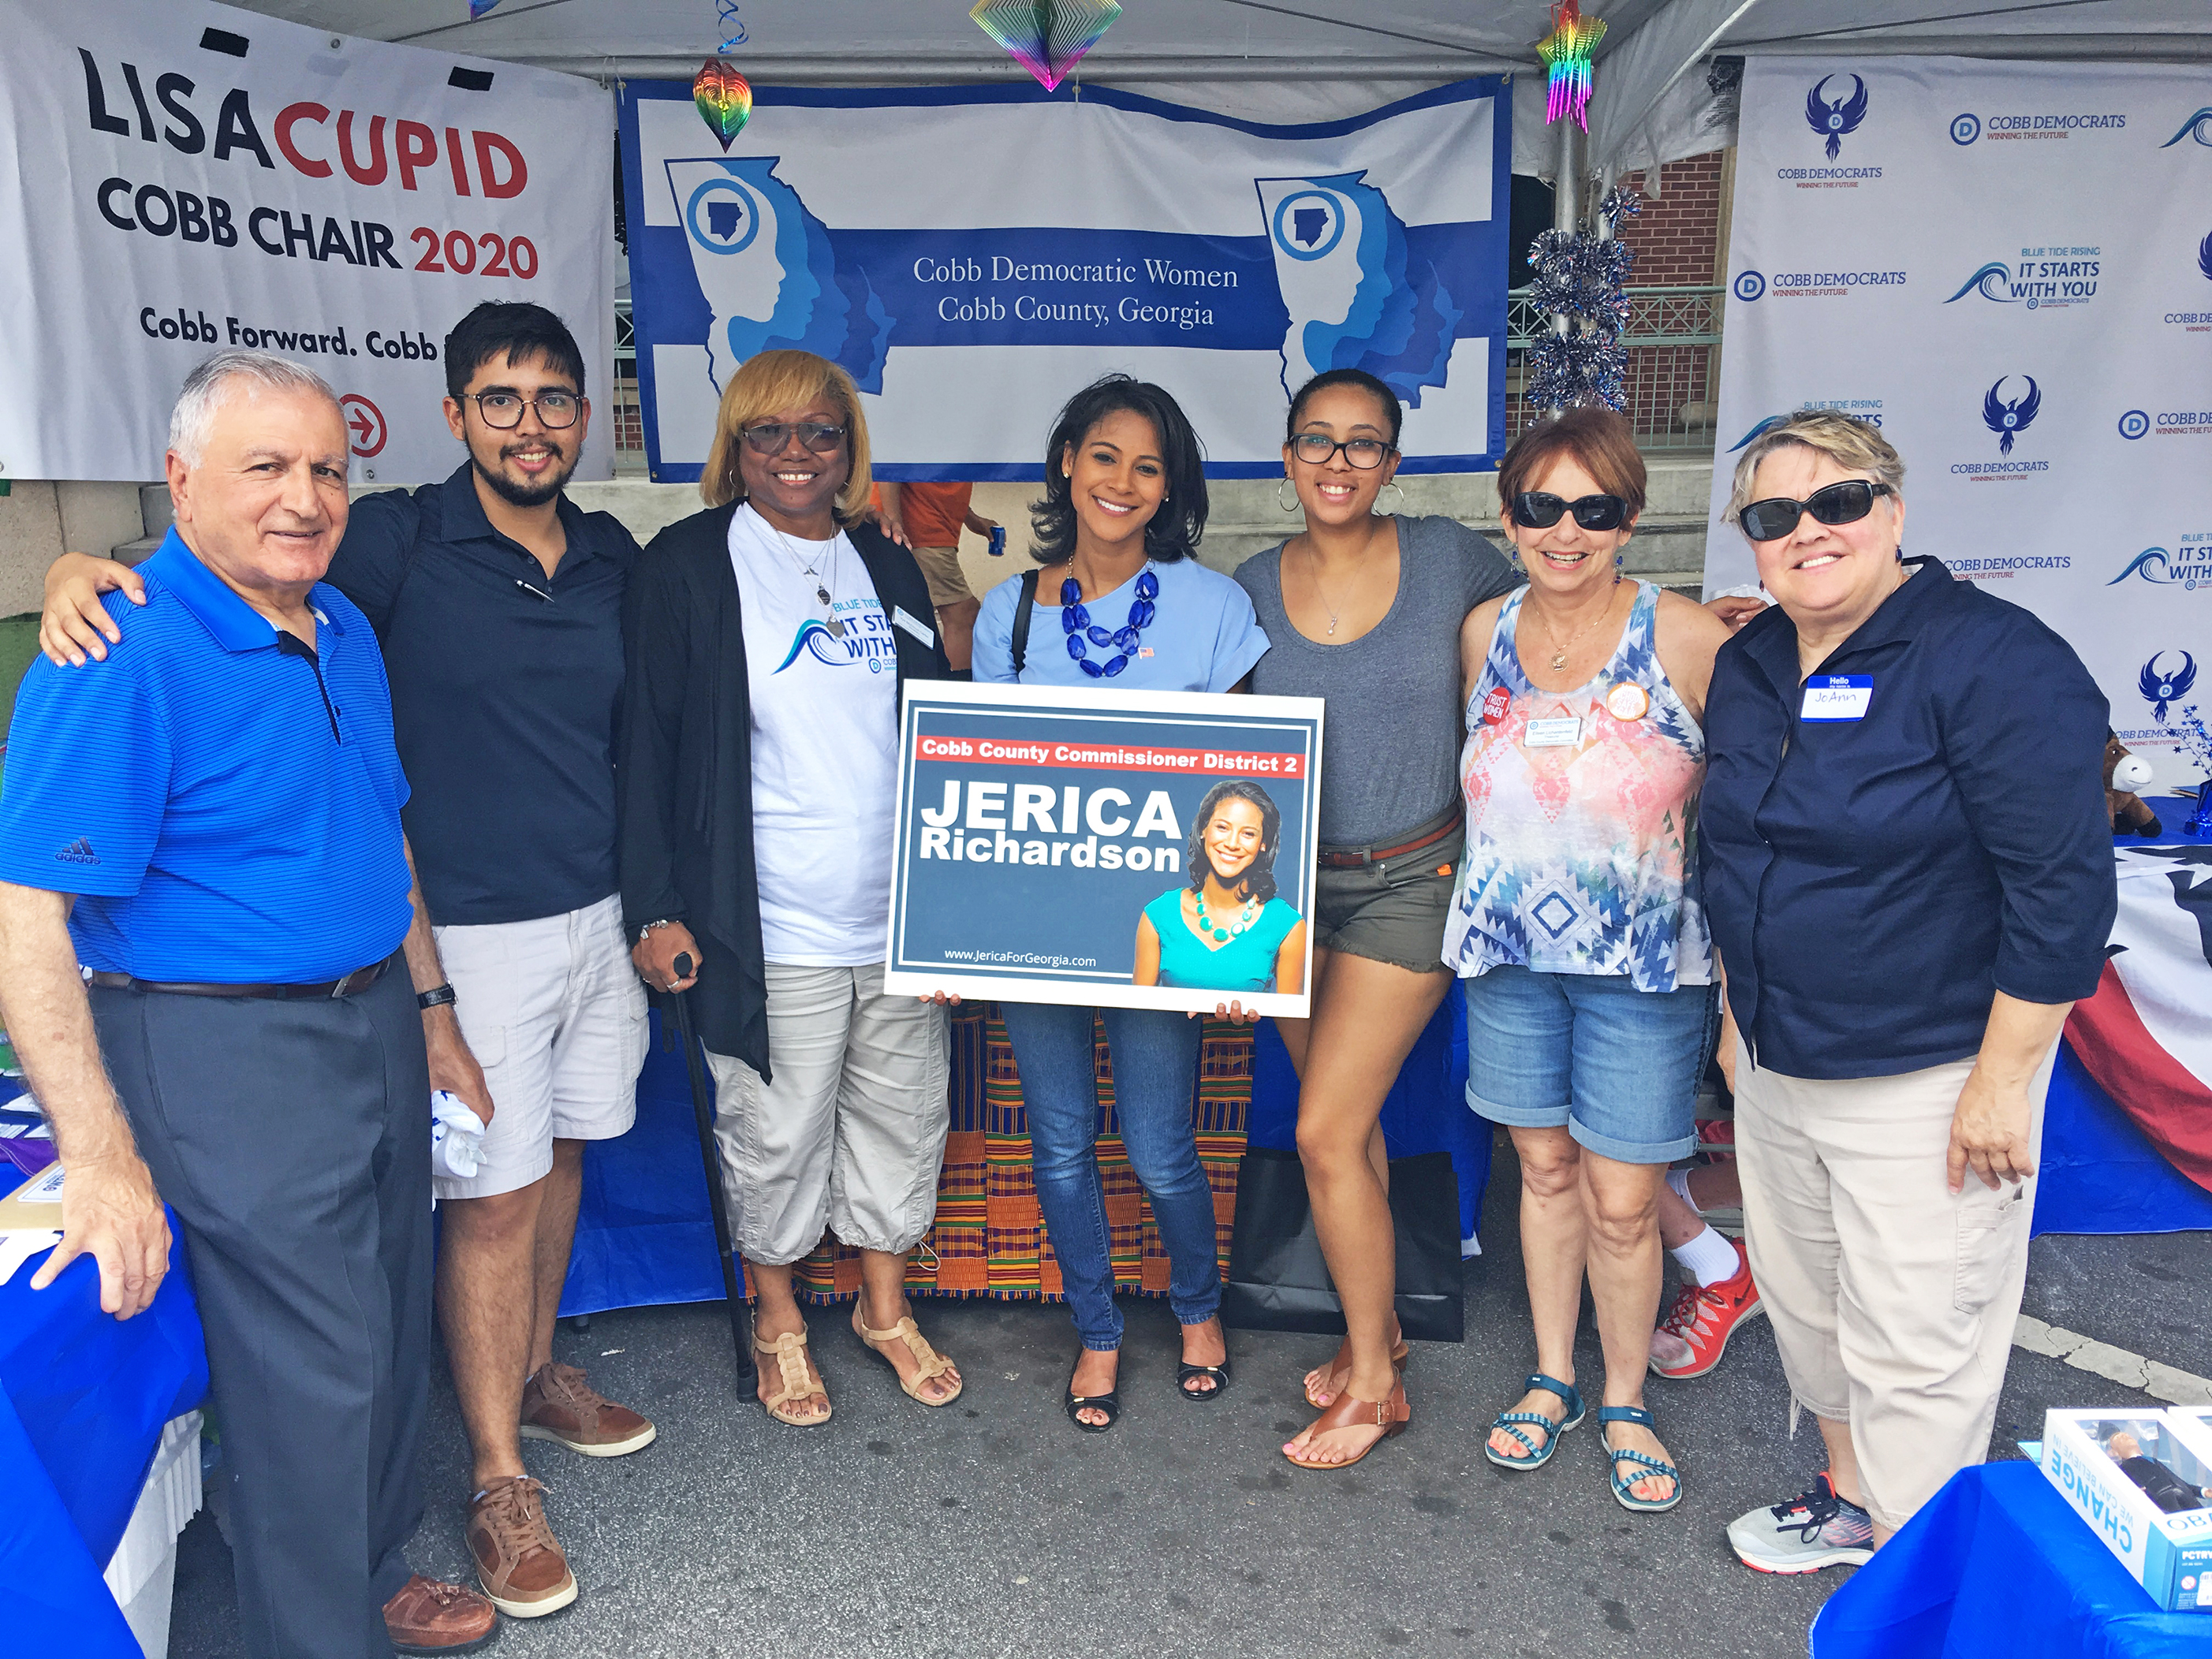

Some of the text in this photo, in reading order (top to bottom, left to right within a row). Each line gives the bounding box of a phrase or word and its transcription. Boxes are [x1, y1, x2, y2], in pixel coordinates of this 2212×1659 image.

[1988, 114, 2126, 130] COBB DEMOCRATS
[1986, 132, 2022, 140] WINNING
[2039, 131, 2069, 140] FUTURE
[1777, 166, 1882, 180] COBB DEMOCRATS
[97, 177, 539, 280] COBB CHAIR 2020
[2021, 246, 2101, 257] BLUE TIDE RISING
[913, 255, 1239, 288] Cobb Democratic Women
[2020, 262, 2100, 278] IT STARTS
[1774, 271, 1907, 287] COBB DEMOCRATS
[2010, 281, 2098, 298] WITH YOU
[938, 295, 1214, 330] Cobb County, Georgia
[2164, 313, 2198, 323] COBB
[140, 307, 218, 344] Cobb
[226, 316, 358, 357] Forward.
[365, 330, 438, 361] Cobb
[1804, 400, 1883, 410] BLUE TIDE RISING
[2157, 412, 2197, 426] COBB
[1950, 461, 2049, 474] COBB DEMOCRATS
[2181, 533, 2204, 542] BLUE
[2178, 547, 2195, 561] IT
[1944, 556, 2071, 572] COBB DEMOCRATS
[2169, 565, 2212, 580] WITH
[833, 598, 861, 613] BLUE
[840, 617, 859, 636] IT
[842, 636, 897, 658] WITH
[1830, 677, 1849, 685] Hello
[1487, 693, 1508, 708] TRUST
[1616, 699, 1636, 710] SAFE
[1815, 691, 1856, 703] JoAnn
[1483, 703, 1504, 719] WOMEN
[2115, 730, 2136, 739] OBB
[921, 739, 1297, 773] Cobb County Commissioner District 2
[920, 779, 1183, 840] JERICA
[919, 826, 1181, 873] Richardson
[54, 852, 102, 866] adidas
[944, 948, 1097, 968] www.JericaForGeorgia.com
[2053, 1433, 2133, 1528] WE CAN BELIEVE IN
[2051, 1448, 2133, 1554] CHANGE
[2167, 1512, 2212, 1530] OB
[2182, 1550, 2212, 1560] FCTRY
